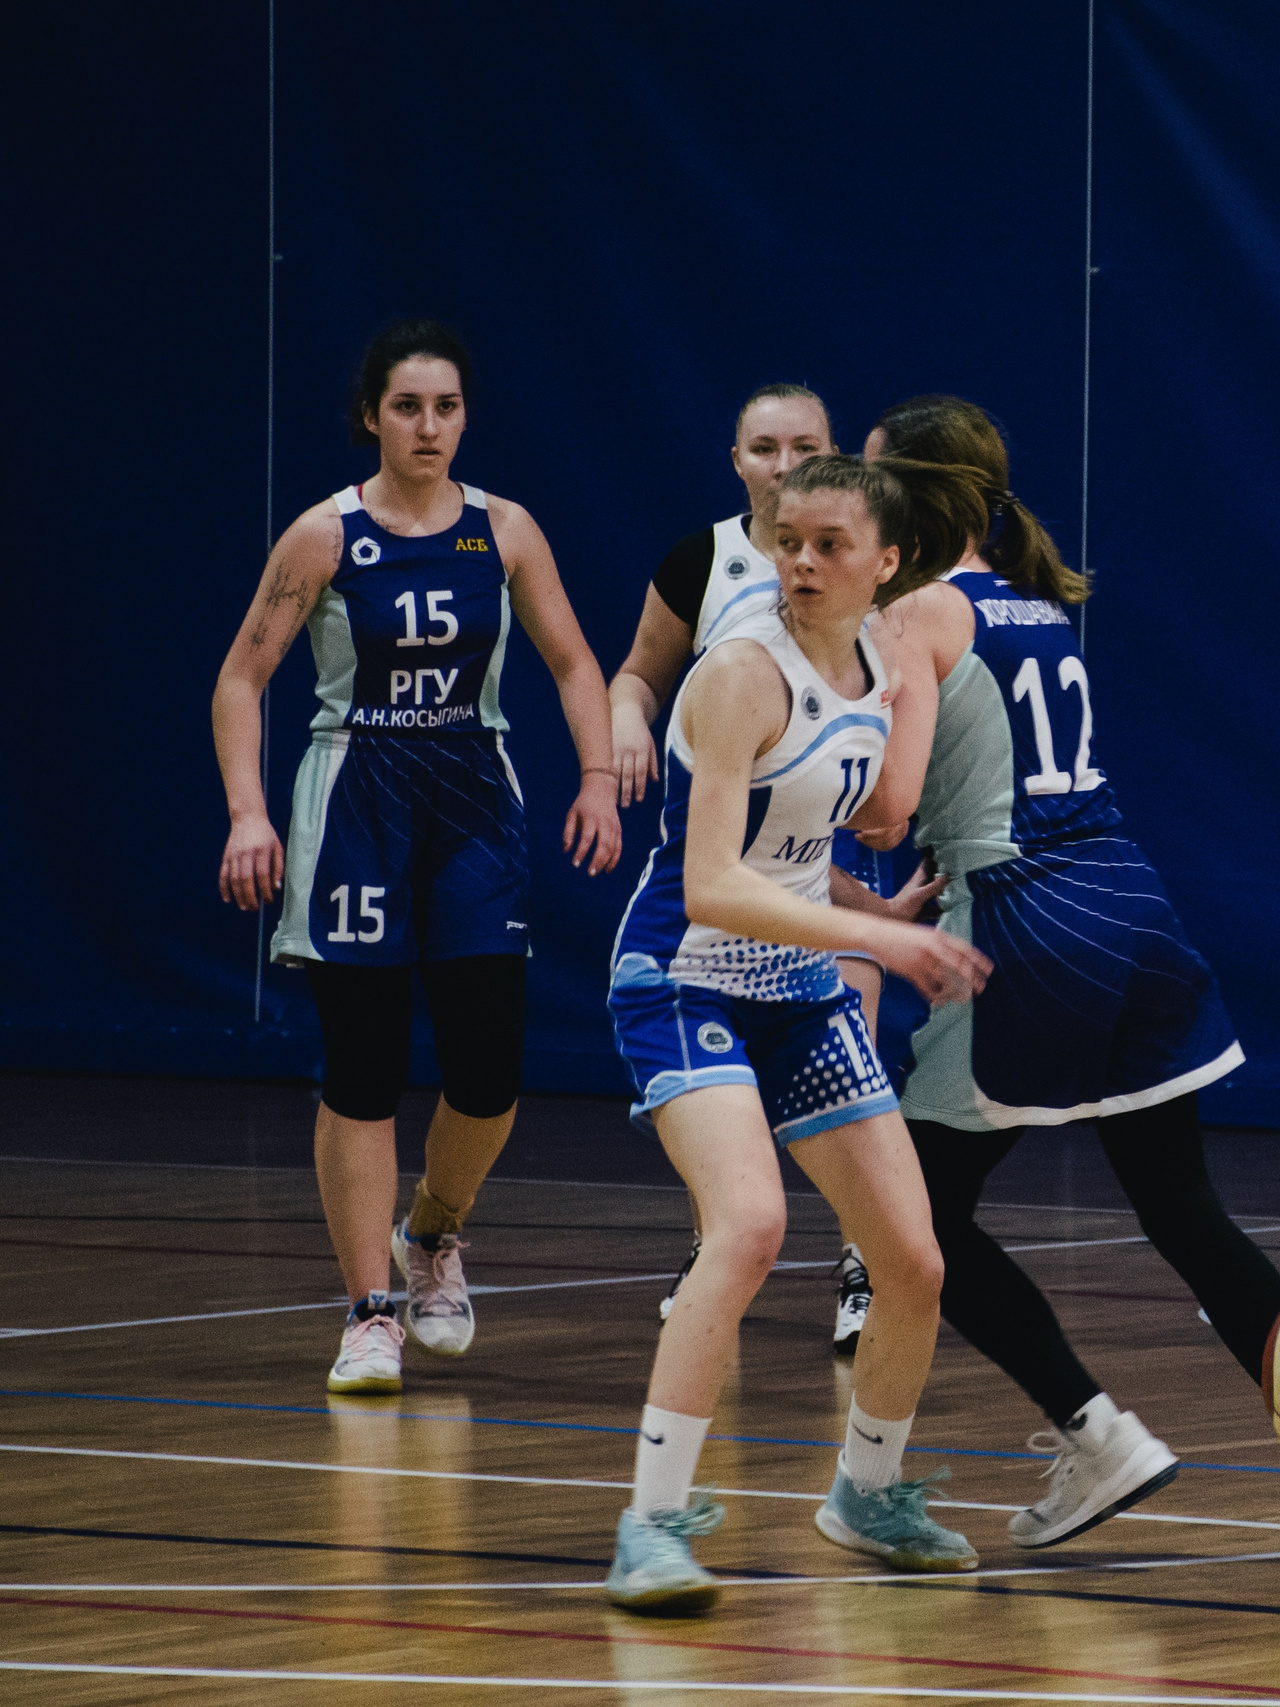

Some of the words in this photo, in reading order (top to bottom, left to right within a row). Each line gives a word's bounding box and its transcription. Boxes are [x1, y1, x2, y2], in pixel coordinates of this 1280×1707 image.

[394, 590, 459, 647] 15
[390, 668, 459, 705] РГУ
[1012, 656, 1107, 796] 12
[828, 757, 871, 823] 11
[327, 884, 386, 943] 15
